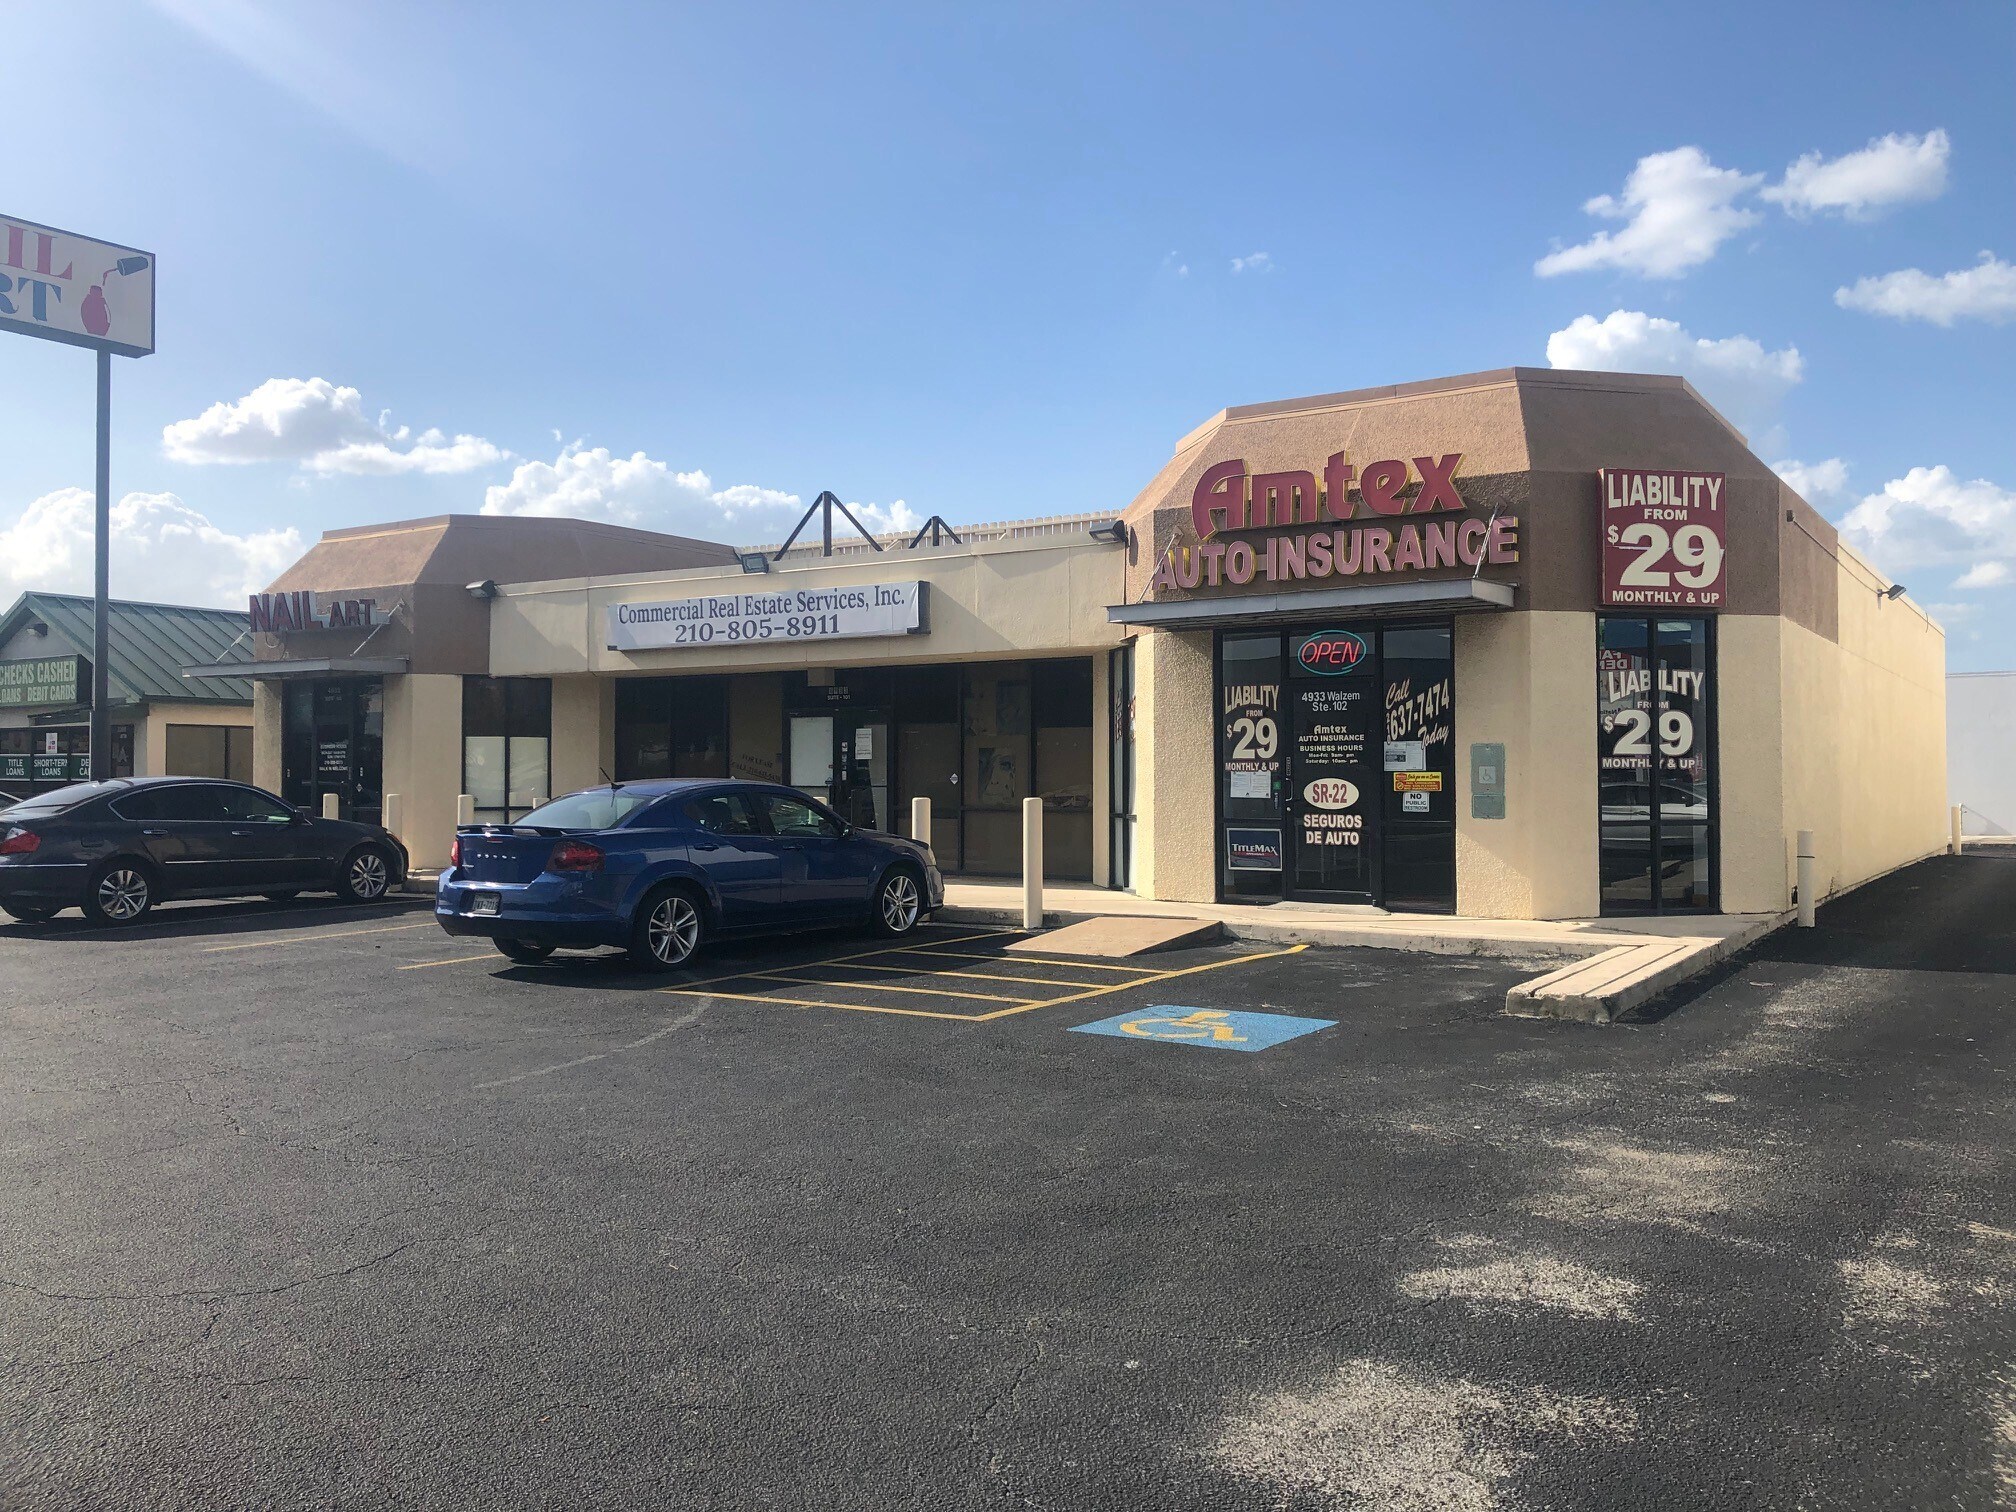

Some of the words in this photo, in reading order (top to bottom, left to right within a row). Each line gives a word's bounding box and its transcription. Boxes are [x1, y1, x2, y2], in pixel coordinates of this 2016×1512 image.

[0, 224, 72, 280] IL
[0, 272, 61, 321] RT
[1191, 450, 1467, 541] Amtex
[1608, 473, 1722, 511] LIABILITY
[1644, 508, 1688, 521] FROM
[1152, 541, 1256, 591] AUTO
[1266, 516, 1520, 581] INSURANCE
[619, 599, 703, 624] Commercial
[709, 596, 739, 618] Real
[744, 594, 792, 616] Estate
[796, 588, 870, 613] Services,
[874, 585, 905, 607] Inc.
[1612, 590, 1681, 603] MONTHLY
[1685, 592, 1696, 603] &
[1701, 592, 1719, 604] UP
[249, 590, 323, 632] NAIL
[329, 598, 376, 628] ART
[675, 614, 840, 643] 210-805-8911
[1301, 641, 1360, 664] OPEN
[37, 660, 76, 683] CASHED
[0, 688, 21, 703] OANS
[27, 686, 48, 702] DEBIT
[50, 684, 76, 701] CARDS
[1386, 677, 1410, 710] Call
[1608, 669, 1704, 703] LIABILITY
[1225, 685, 1279, 715] LIABILITY
[1301, 691, 1325, 702] 4933
[1326, 691, 1360, 701] Walzem
[1312, 702, 1332, 712] Ste.
[1332, 701, 1348, 711] 102
[1246, 709, 1263, 717] FROM
[1390, 678, 1450, 741] 637-7474
[1313, 725, 1347, 734] Amtex
[1320, 734, 1364, 742] INSURANCE
[1417, 722, 1449, 750] Today
[6, 767, 25, 776] LOANS
[8, 759, 23, 767] TITLE
[41, 767, 61, 776] LOANS
[1225, 762, 1259, 771] MONTHLY
[1261, 762, 1267, 770] &
[1269, 762, 1279, 770] UP
[1667, 758, 1677, 768] &
[1679, 759, 1696, 769] UP
[1312, 783, 1347, 803] SR-22
[1303, 814, 1362, 828] SEGUROS
[1306, 831, 1322, 844] DE
[1325, 831, 1360, 845] AUTO
